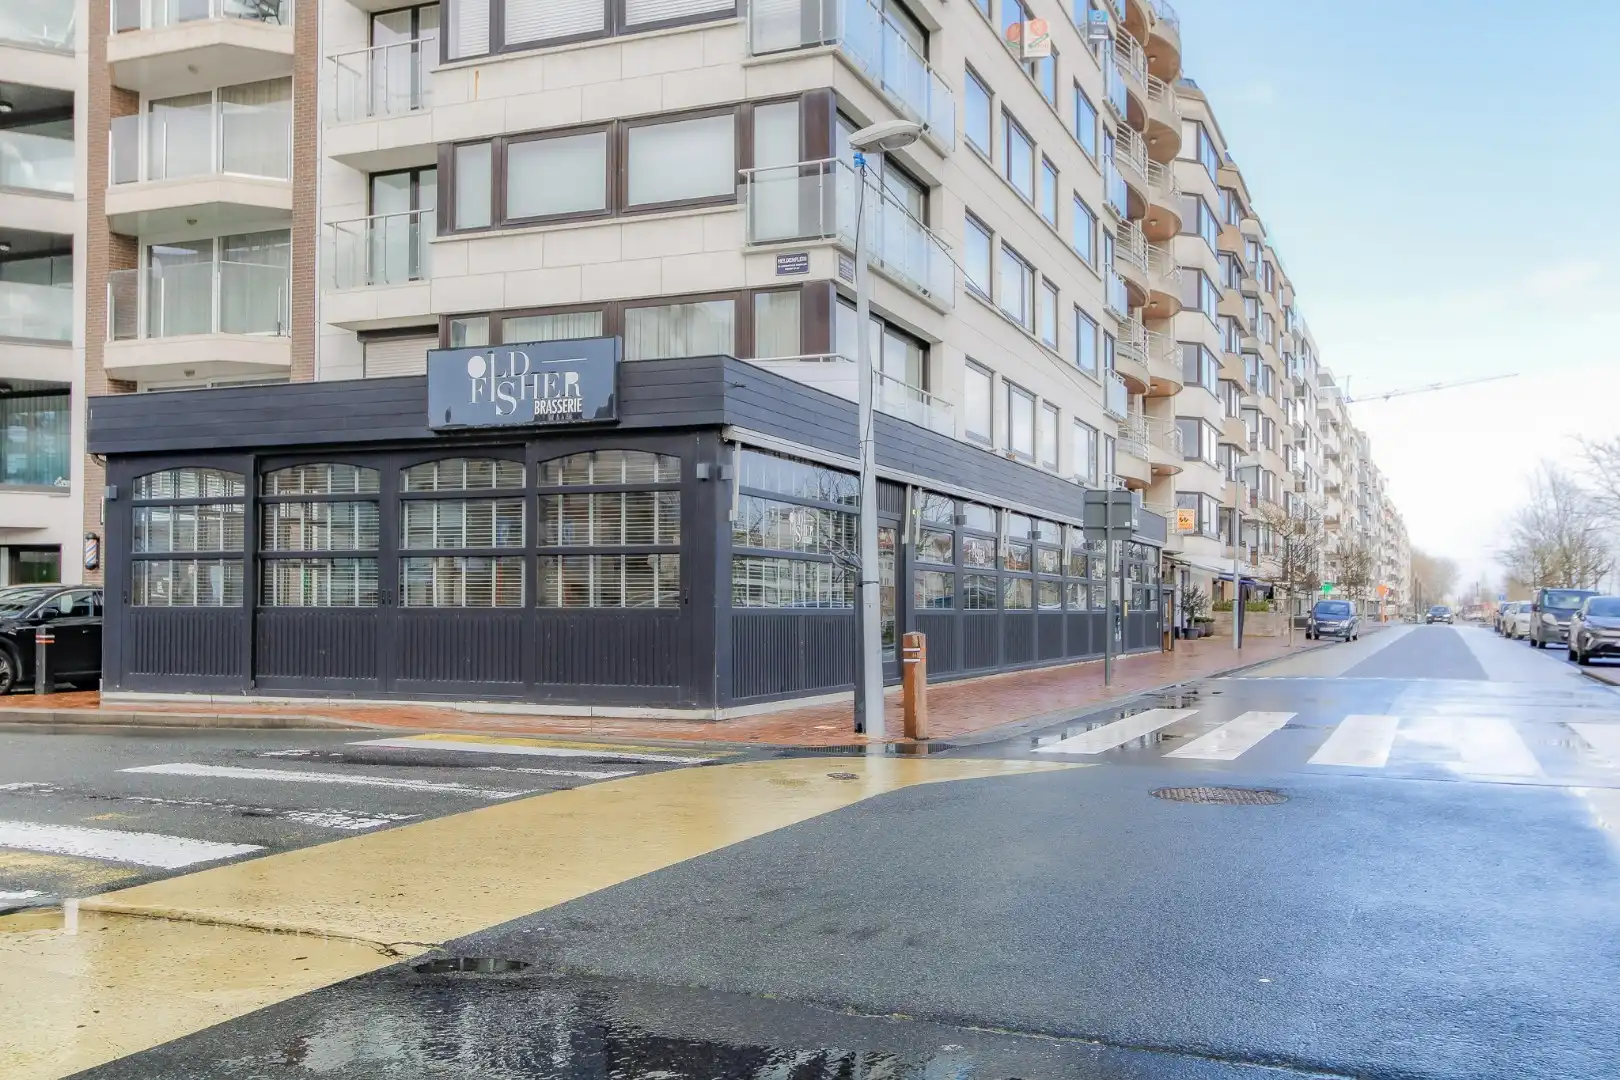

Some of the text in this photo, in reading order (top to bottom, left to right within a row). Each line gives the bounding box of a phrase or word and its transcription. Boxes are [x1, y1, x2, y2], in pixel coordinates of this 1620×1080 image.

[467, 351, 530, 379] OLD
[468, 371, 581, 416] FISHER
[534, 398, 583, 415] BRASSERIE
